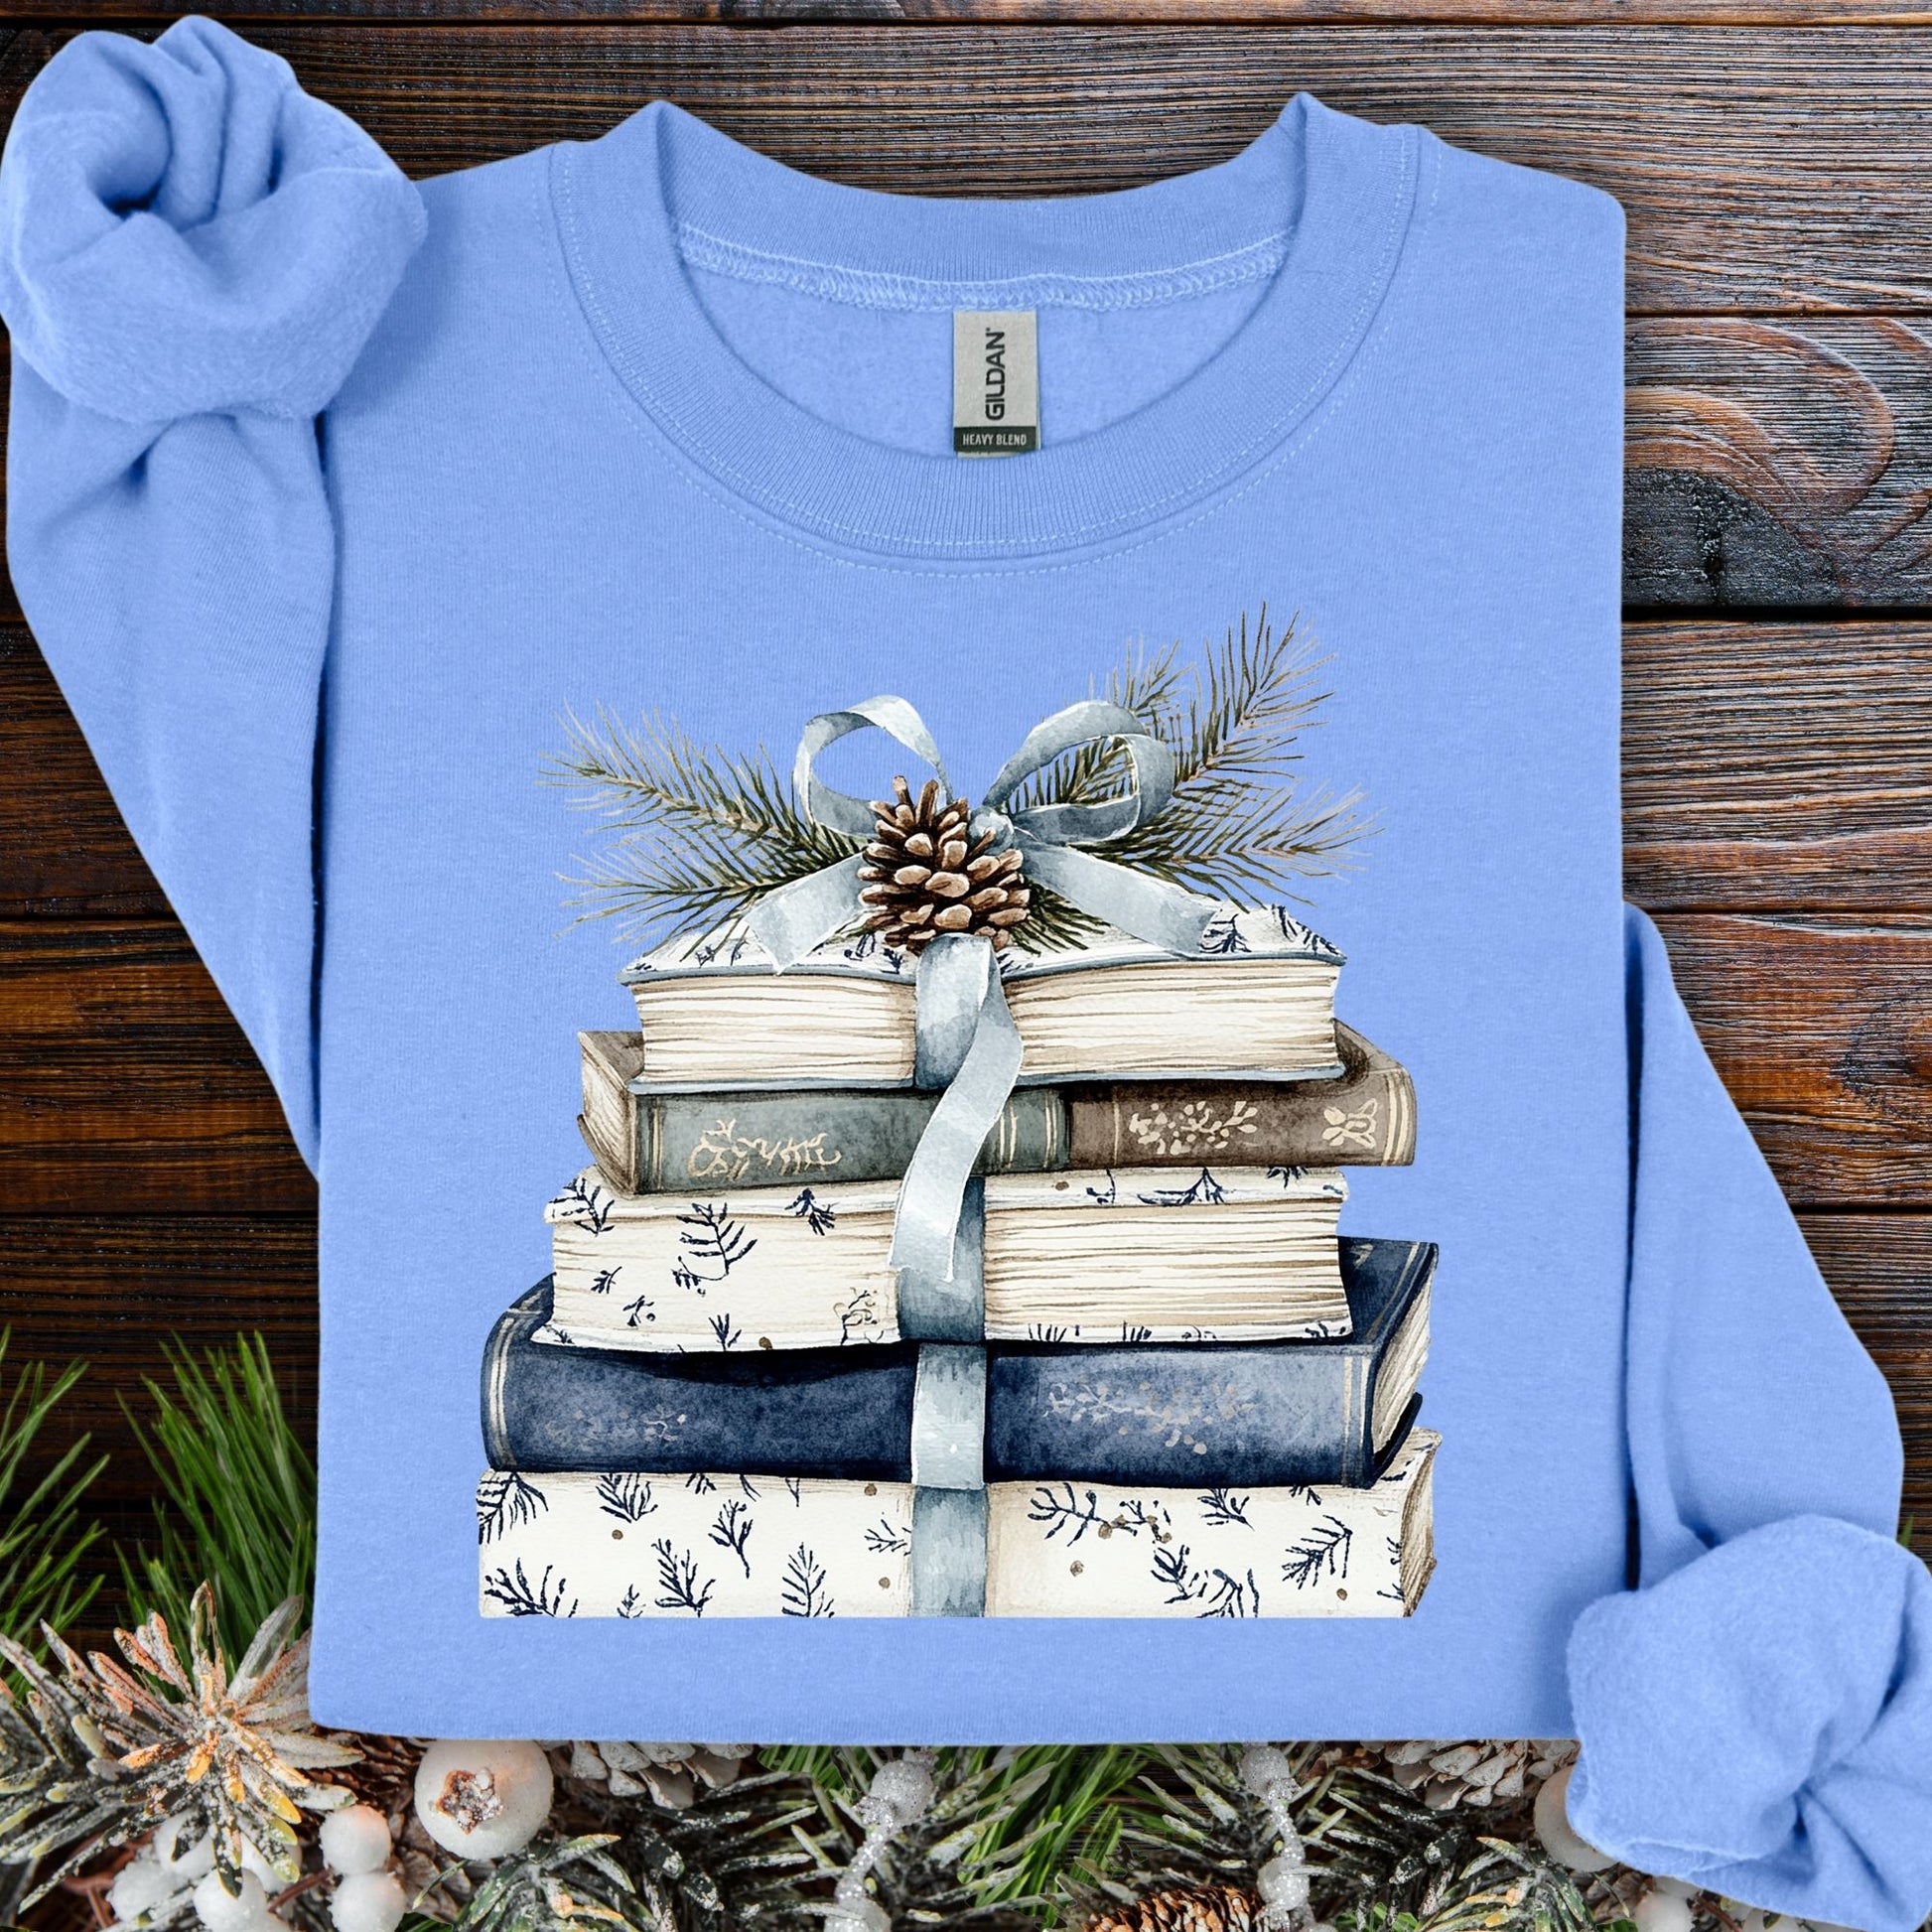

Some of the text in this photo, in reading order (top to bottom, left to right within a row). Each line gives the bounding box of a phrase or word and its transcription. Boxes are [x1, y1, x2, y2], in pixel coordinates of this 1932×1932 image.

[985, 331, 1006, 421] GILDAN
[962, 434, 1028, 446] HEAVY BLEND
